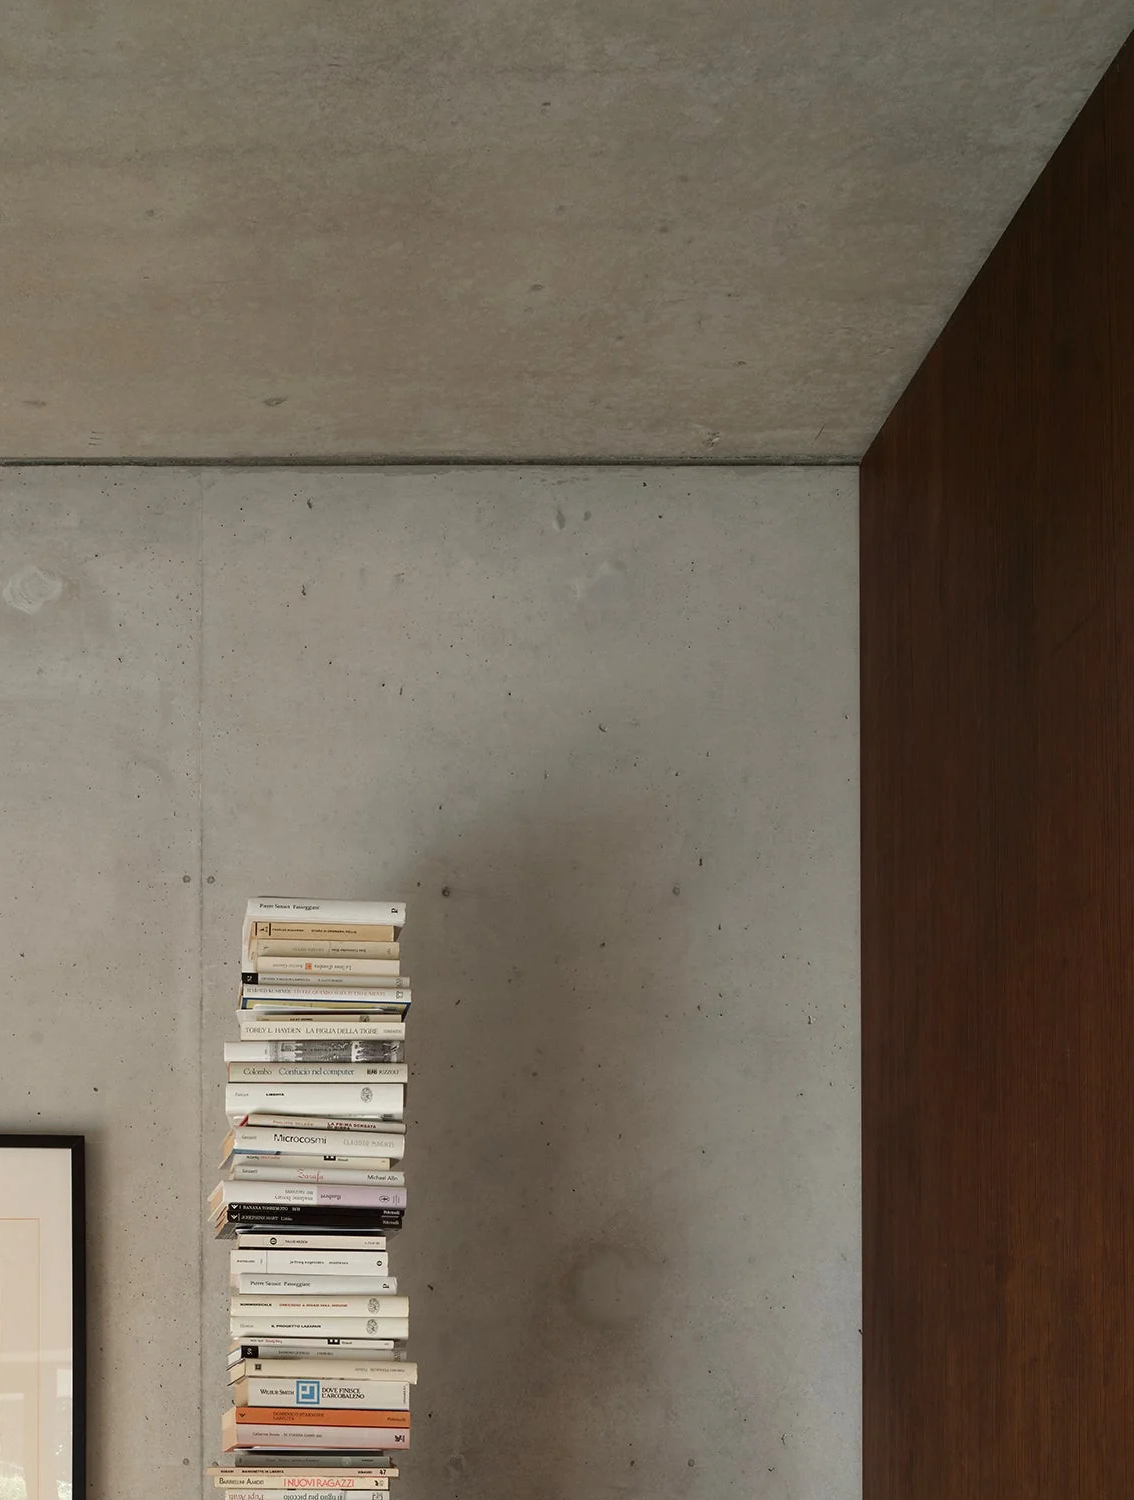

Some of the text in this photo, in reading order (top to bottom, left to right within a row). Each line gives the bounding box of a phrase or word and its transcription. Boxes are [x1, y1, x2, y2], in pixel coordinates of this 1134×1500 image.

[243, 1067, 272, 1076] Colombo
[278, 1067, 355, 1078] Confucio nel computer
[273, 1134, 326, 1144] Microcosmi
[287, 1479, 314, 1487] NUOVI
[317, 1479, 354, 1487] RAGAZZI
[247, 1492, 264, 1500] Pupi
